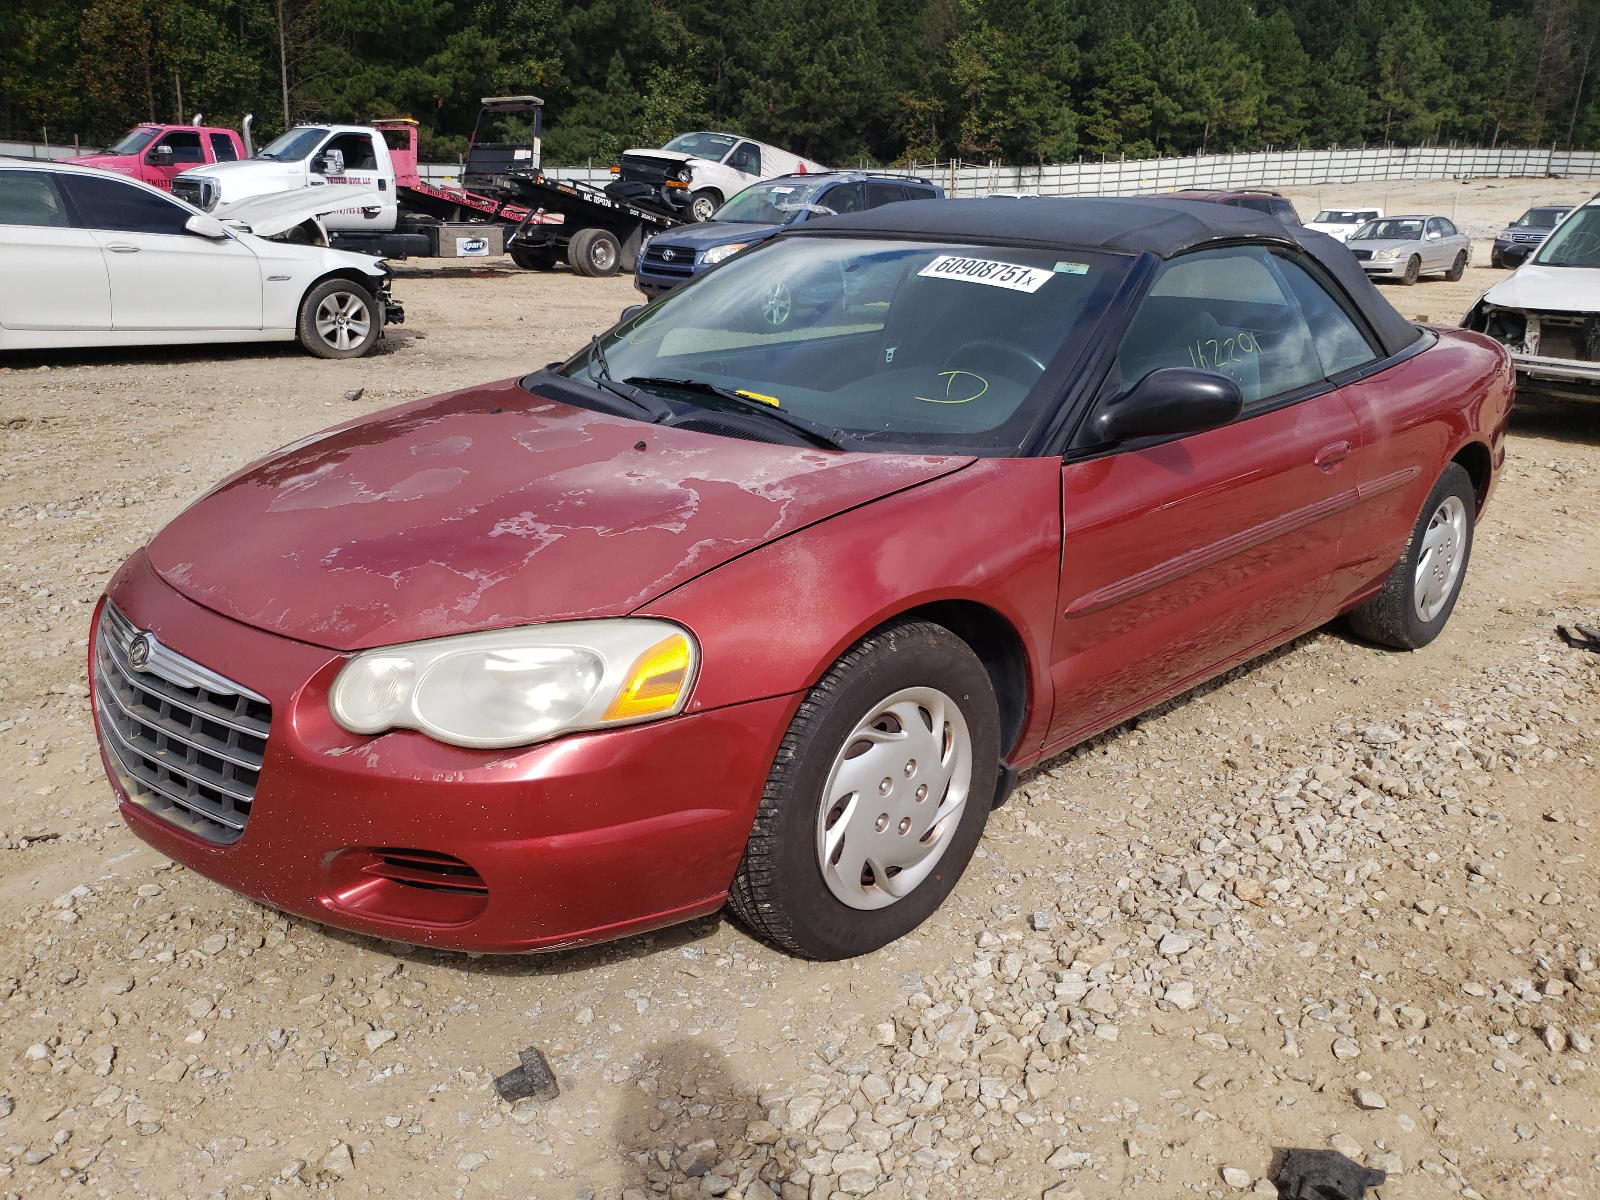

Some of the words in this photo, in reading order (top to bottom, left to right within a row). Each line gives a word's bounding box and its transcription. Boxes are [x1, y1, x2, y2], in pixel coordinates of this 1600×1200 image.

[146, 179, 171, 188] TWISTE
[583, 192, 592, 202] MC
[629, 208, 640, 216] DOT
[462, 241, 485, 250] opart
